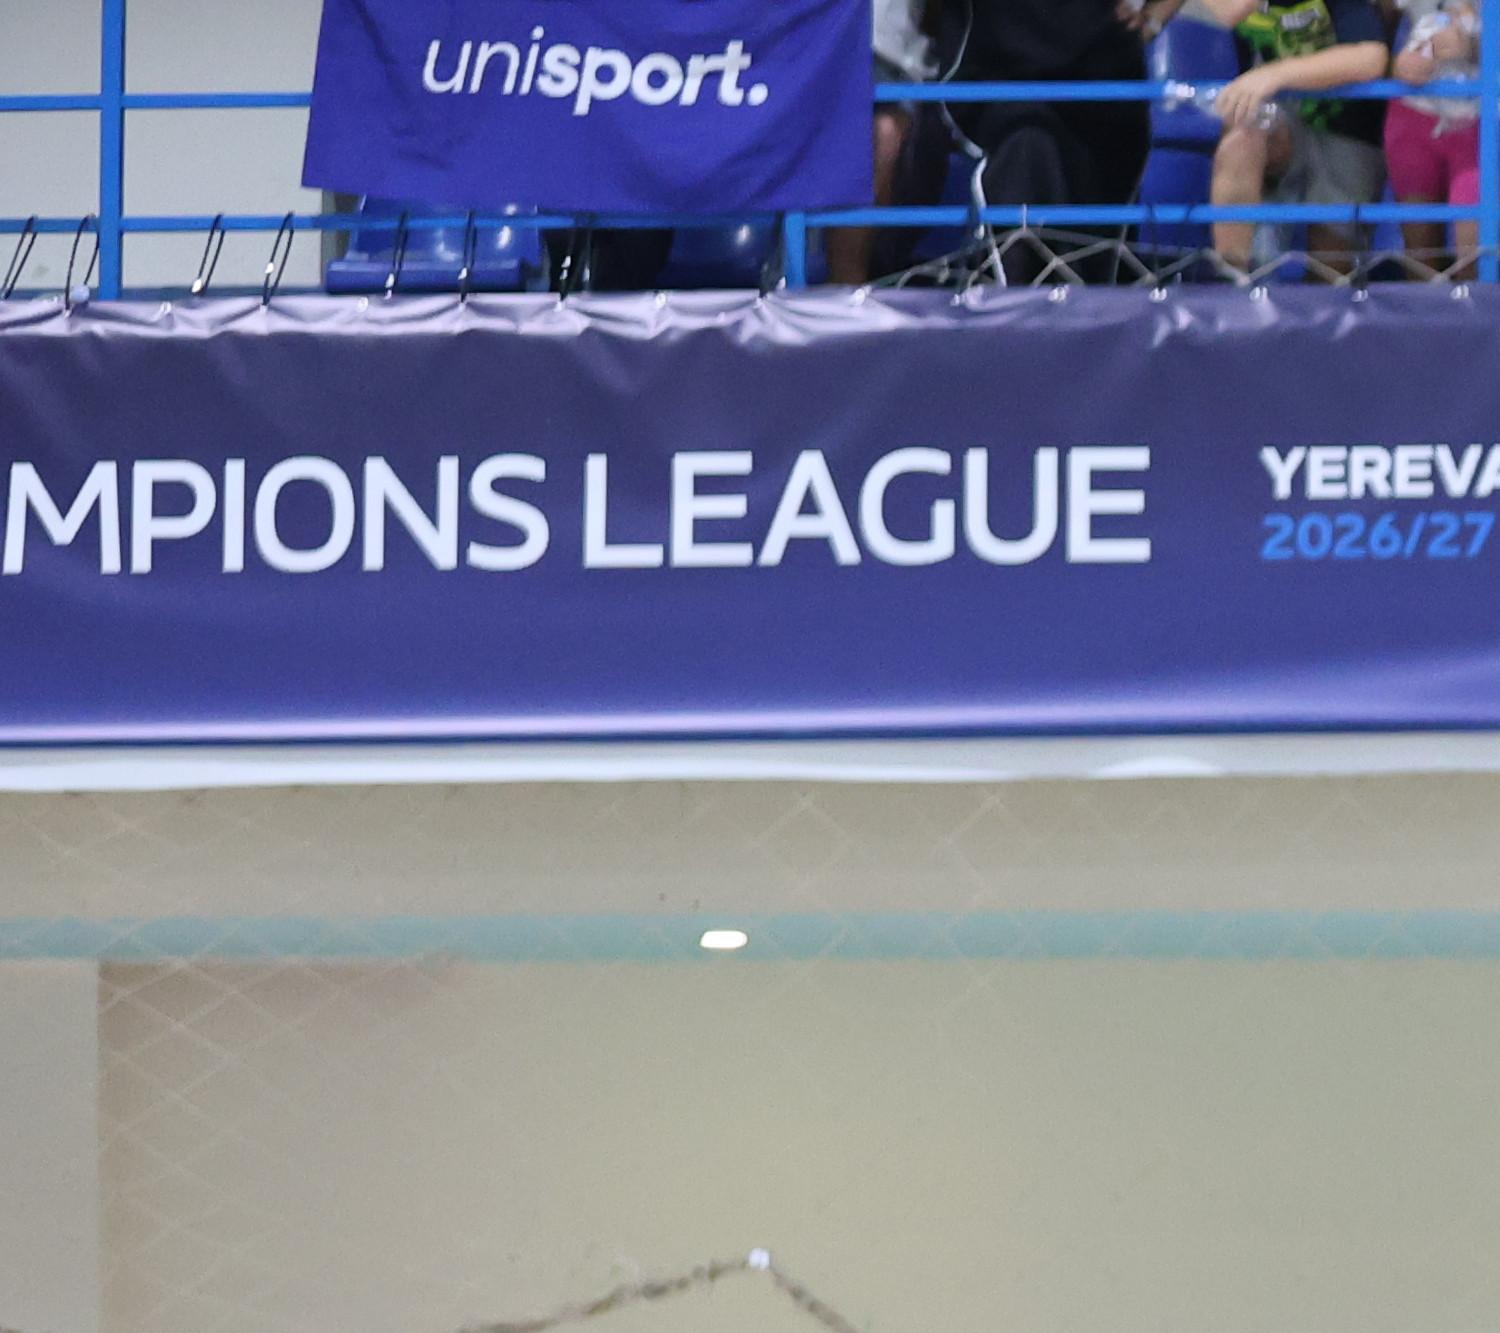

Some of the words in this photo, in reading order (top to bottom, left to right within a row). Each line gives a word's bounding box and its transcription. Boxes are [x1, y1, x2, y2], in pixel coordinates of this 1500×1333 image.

[422, 26, 768, 116] unisport.
[2, 453, 550, 576] MPIONS
[584, 446, 1151, 568] LEAGUE
[1262, 511, 1496, 560] 2026/27
